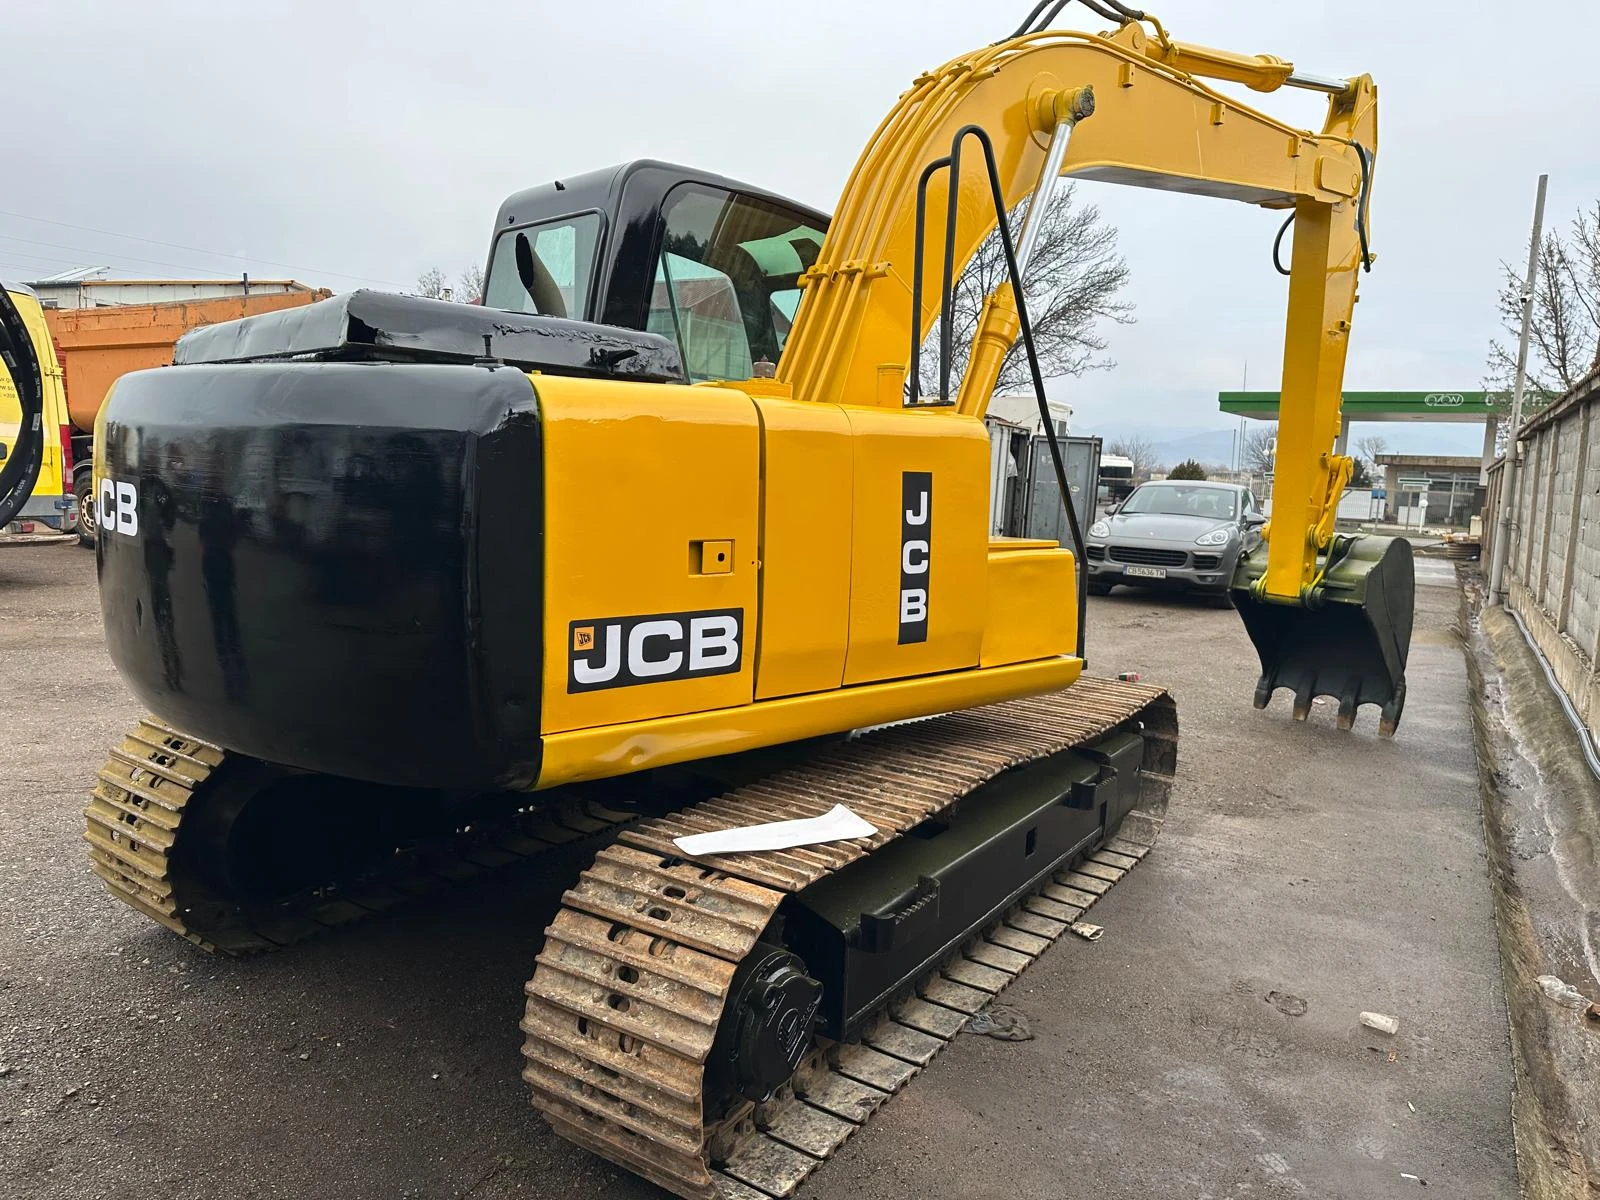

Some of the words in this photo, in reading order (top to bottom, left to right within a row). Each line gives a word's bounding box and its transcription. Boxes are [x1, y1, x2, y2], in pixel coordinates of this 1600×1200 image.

[95, 477, 138, 536] JCB
[900, 491, 929, 623] JCB
[573, 615, 739, 684] JCB
